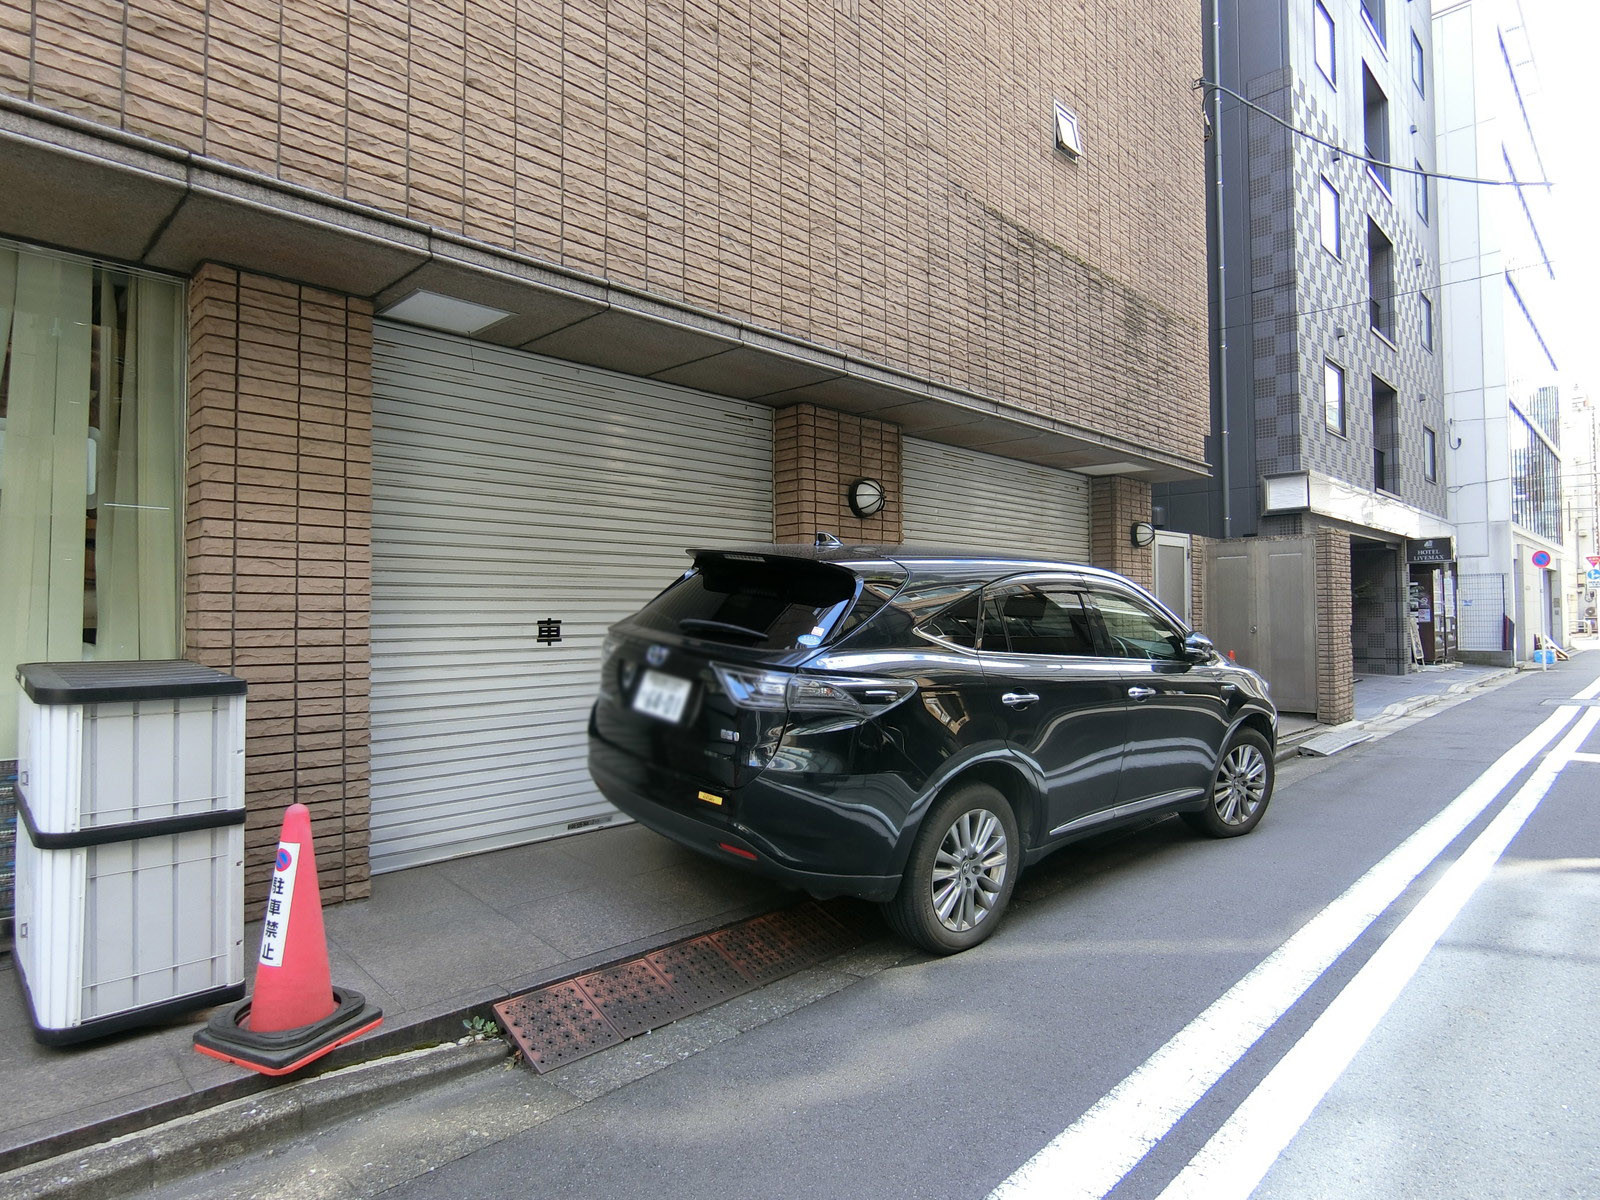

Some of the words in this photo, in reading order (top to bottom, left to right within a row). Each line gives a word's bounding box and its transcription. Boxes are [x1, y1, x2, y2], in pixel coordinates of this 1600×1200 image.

[537, 617, 562, 646] 車
[261, 876, 285, 961] 駐車禁止
